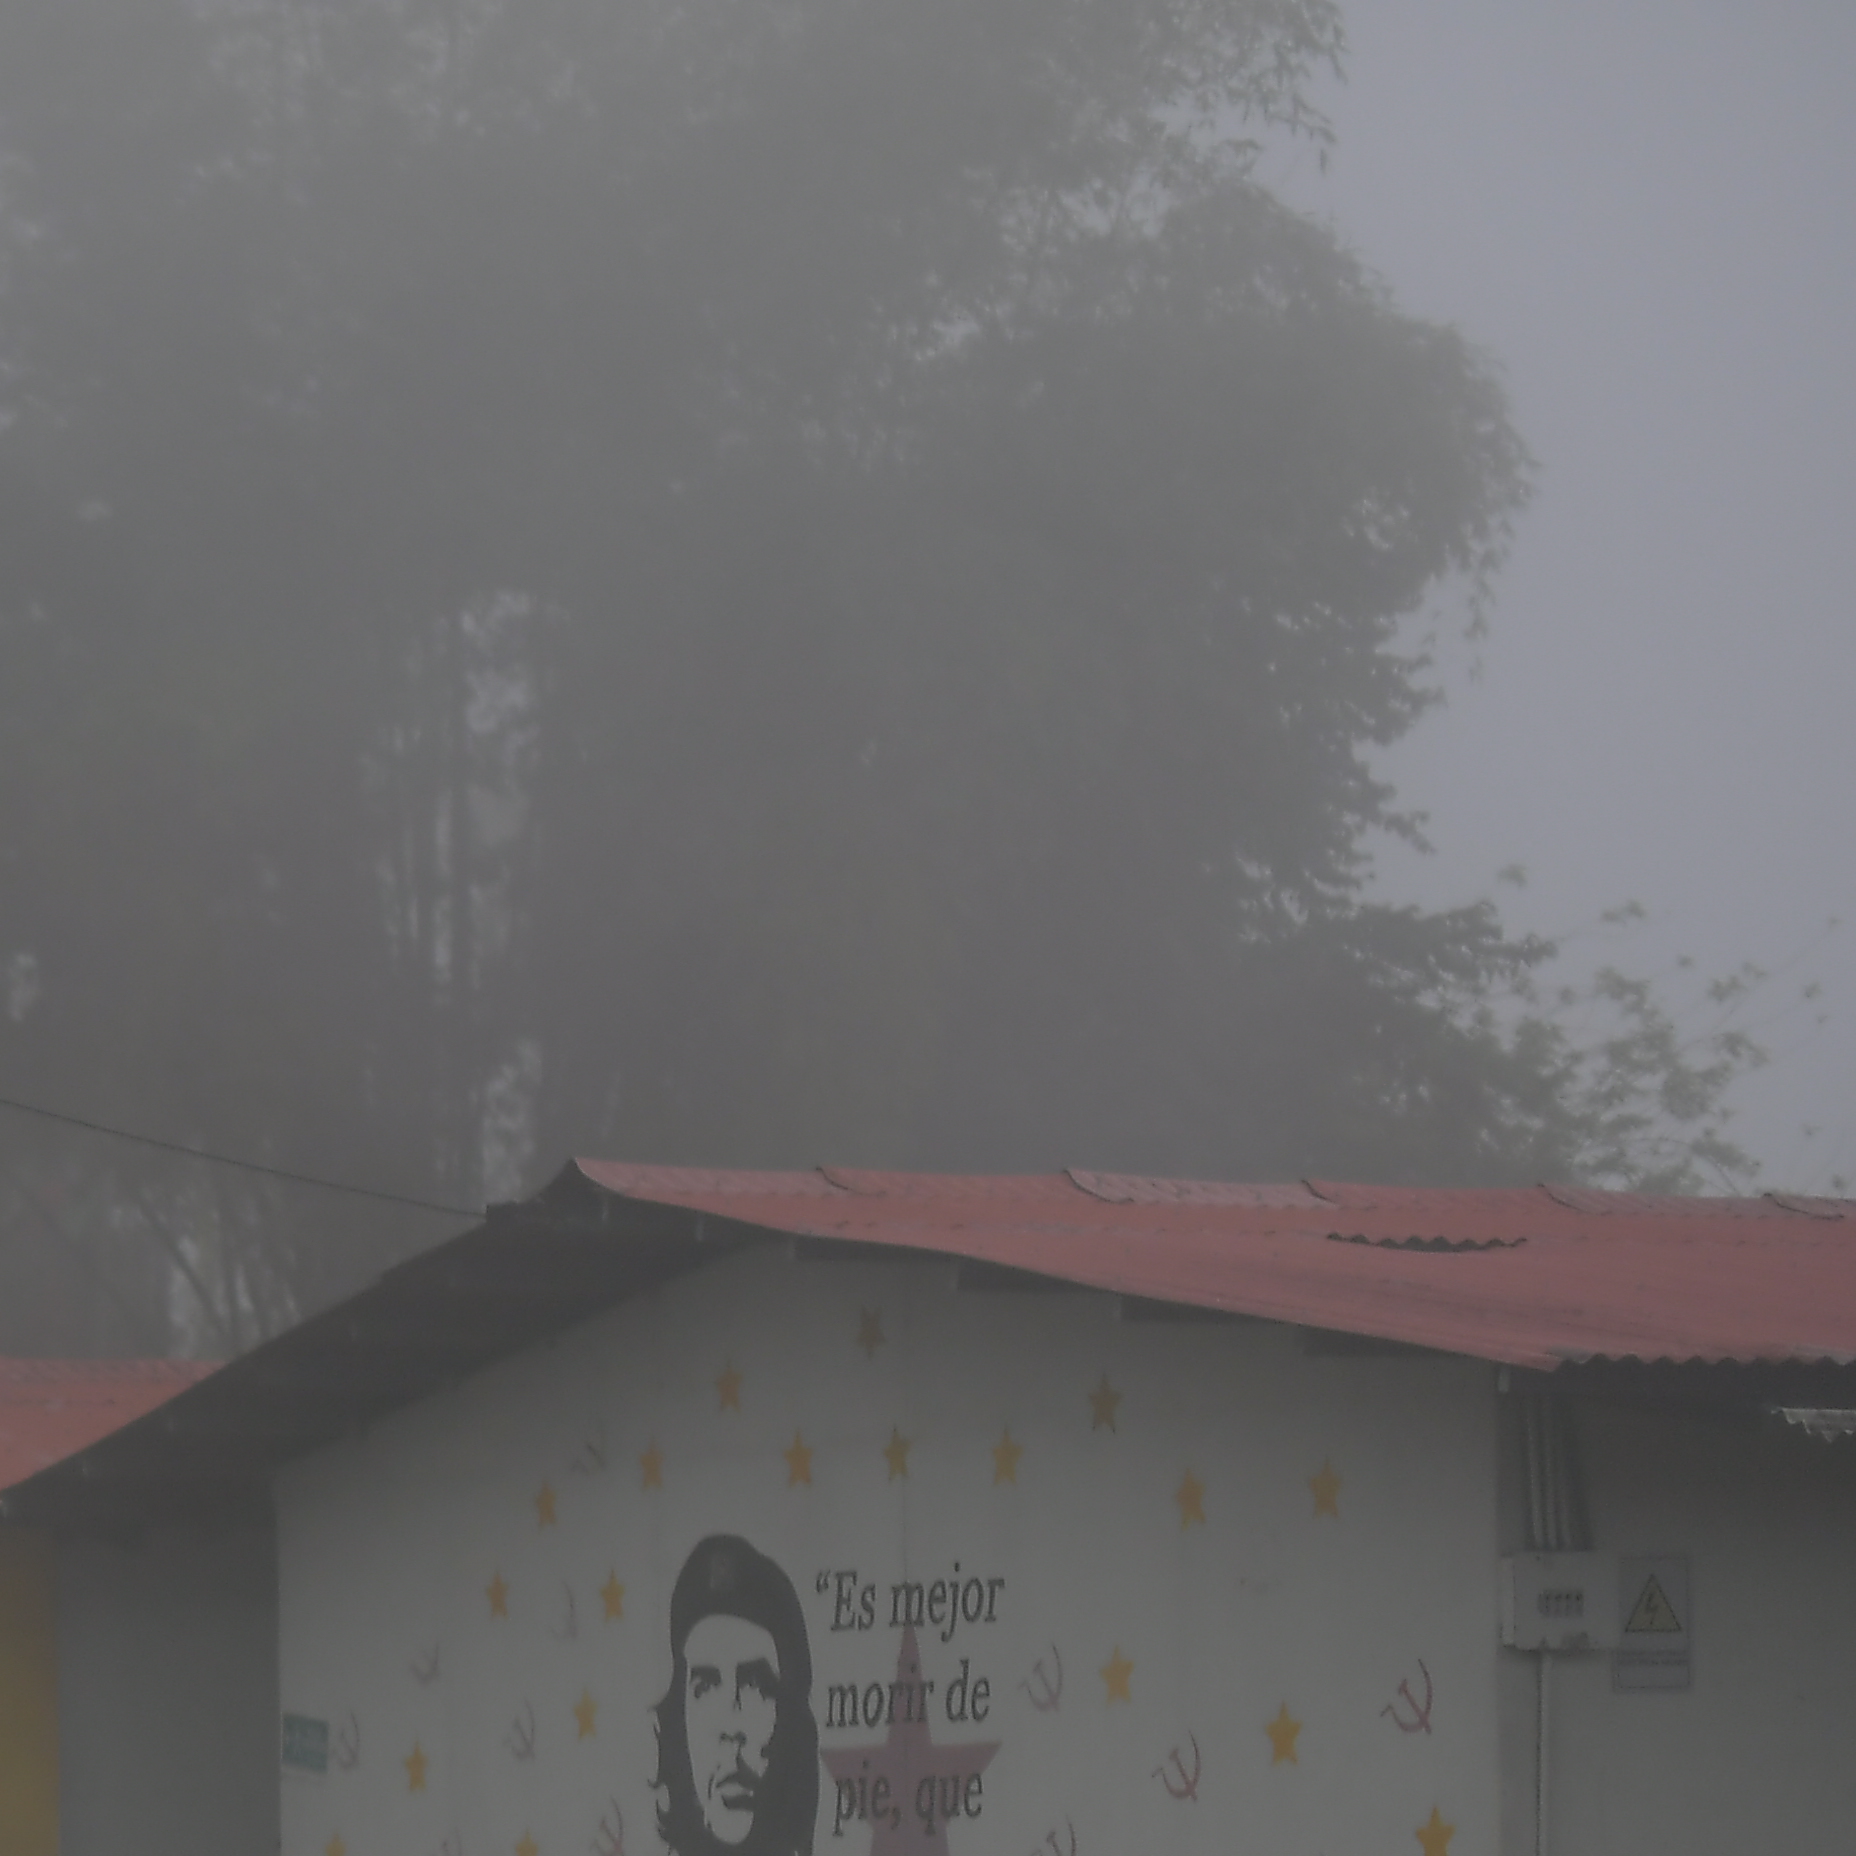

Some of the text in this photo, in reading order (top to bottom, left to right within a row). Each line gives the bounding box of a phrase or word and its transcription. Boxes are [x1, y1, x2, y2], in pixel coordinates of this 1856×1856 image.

[888, 1561, 1005, 1642] mejor
[826, 1657, 992, 1728] morir de
[832, 1760, 984, 1837] pie, que
